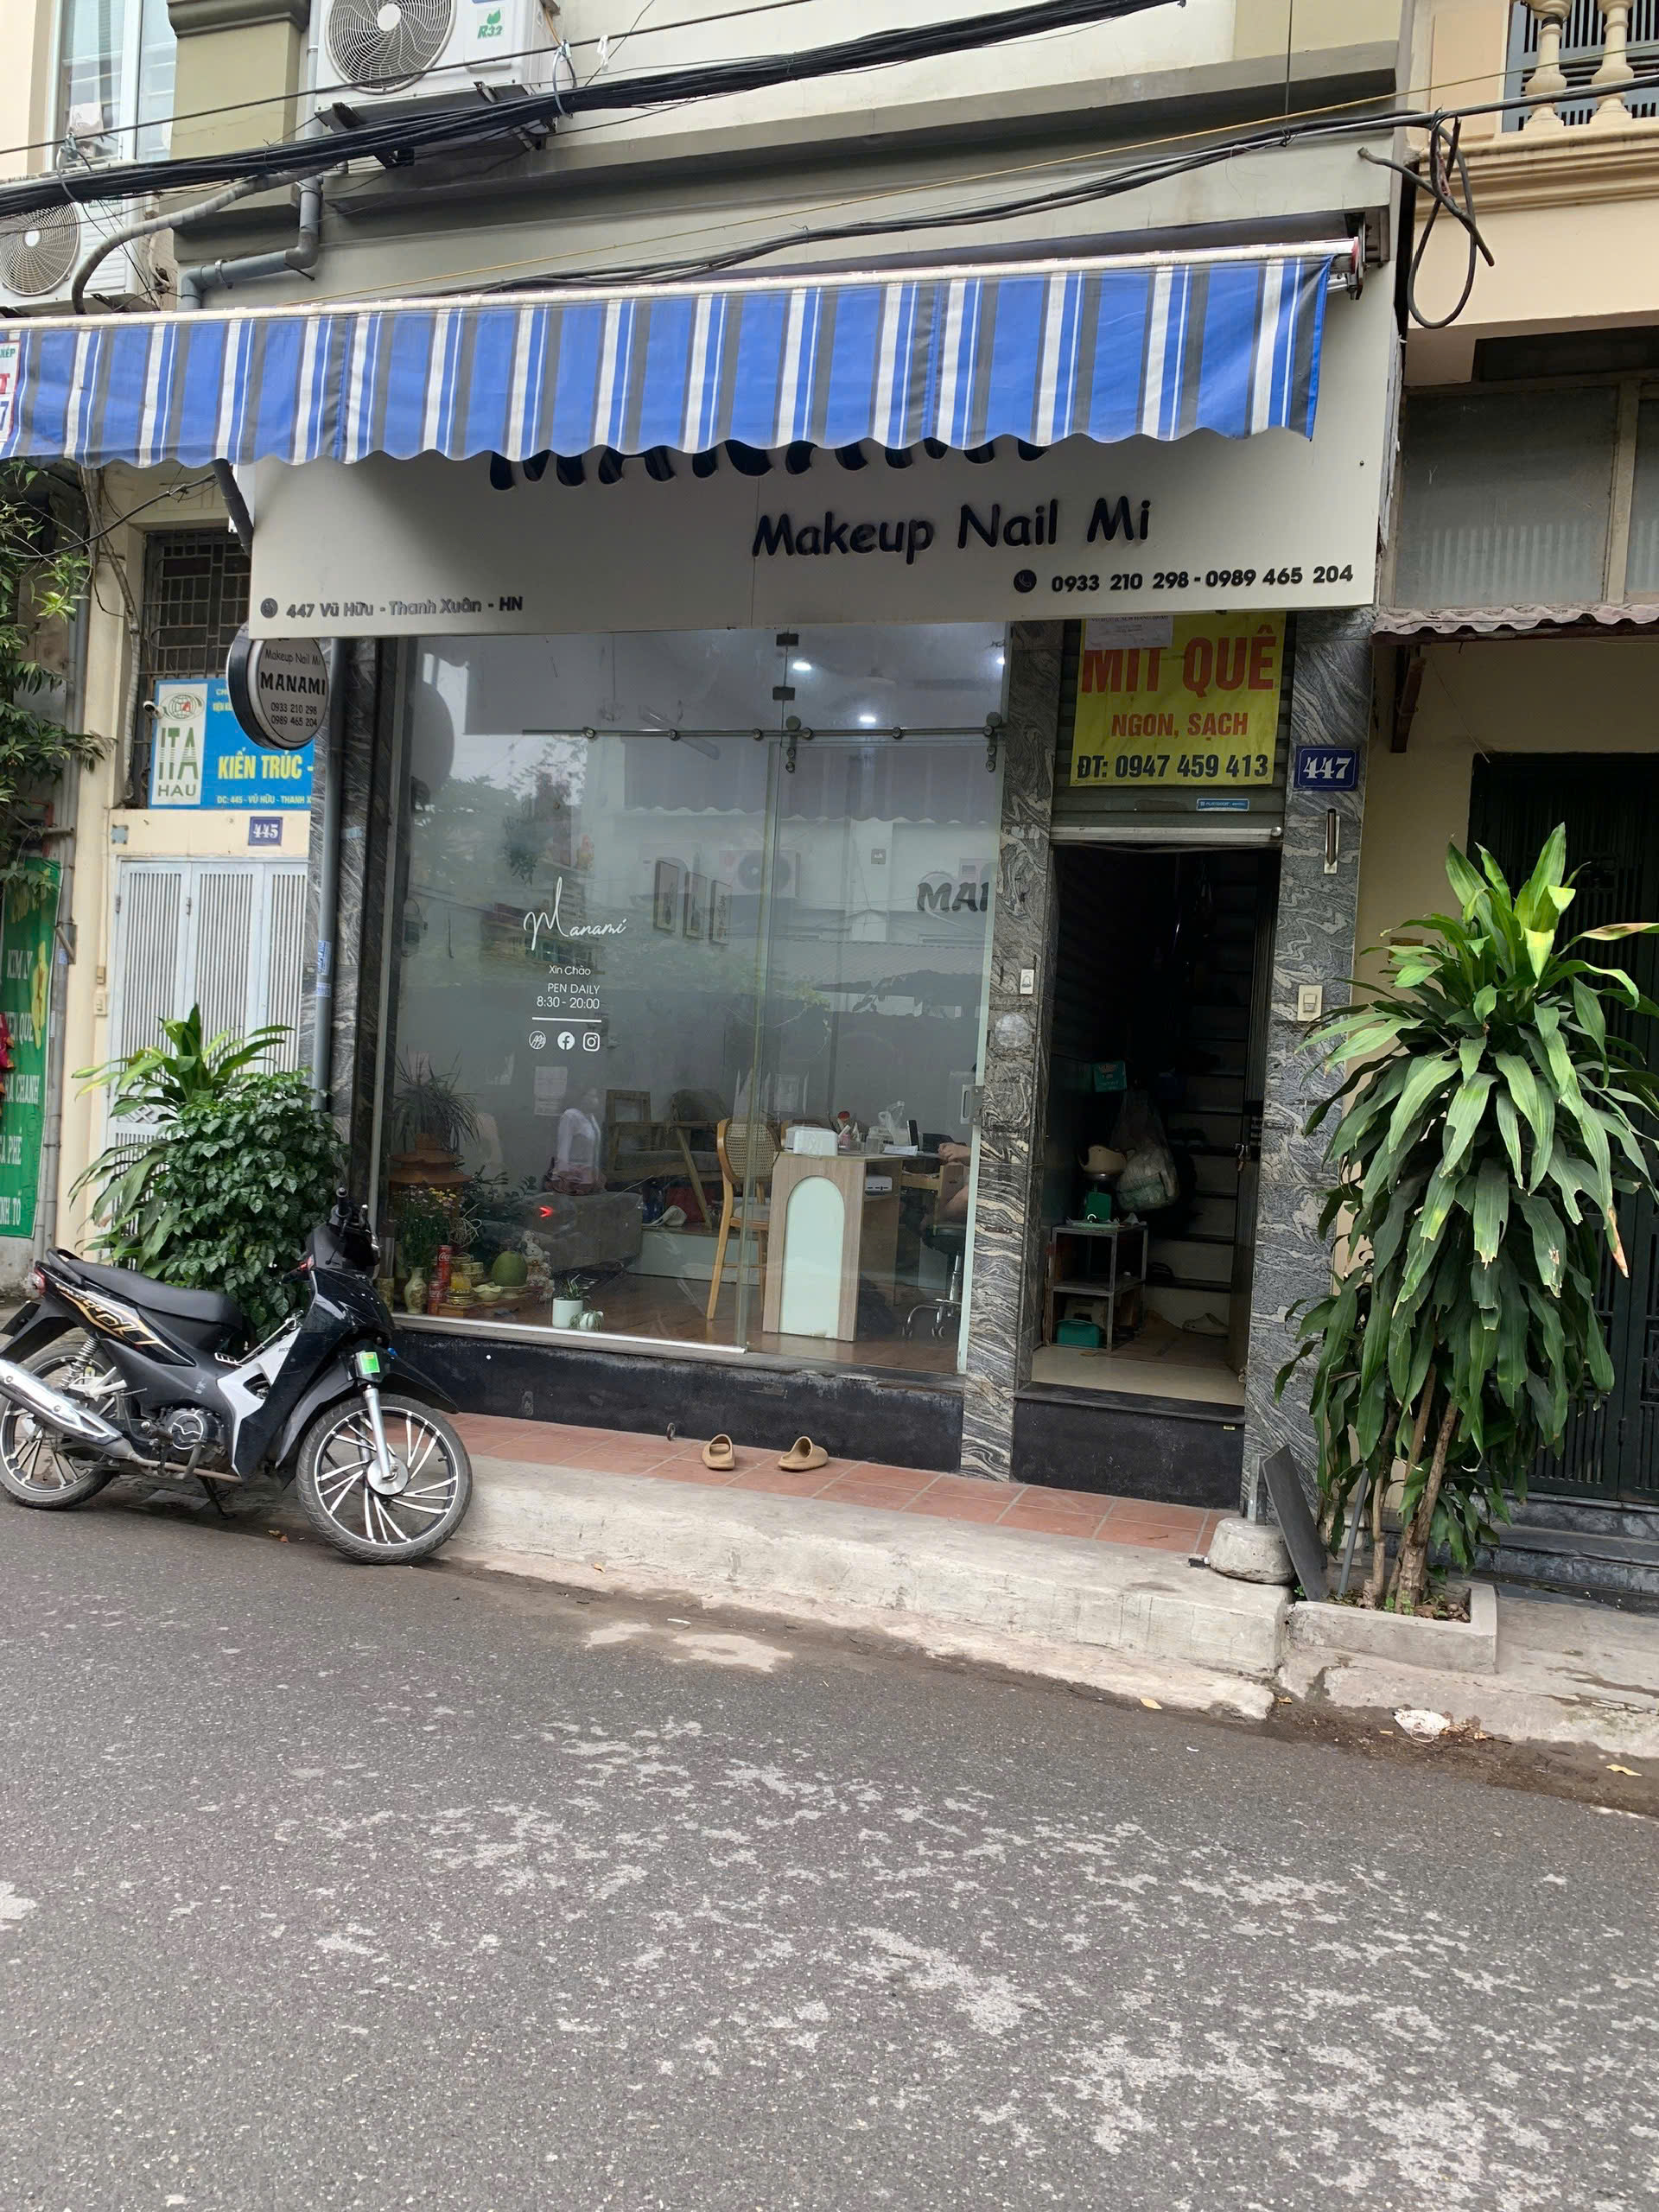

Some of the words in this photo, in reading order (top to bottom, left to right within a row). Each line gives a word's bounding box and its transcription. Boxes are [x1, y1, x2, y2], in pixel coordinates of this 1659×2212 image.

[477, 25, 503, 39] R32
[752, 511, 934, 565] Makeup
[957, 499, 1058, 549] Nail
[1086, 495, 1151, 543] Mi
[1051, 575, 1100, 592] 0933
[1109, 573, 1142, 591] 210
[1206, 569, 1256, 588] 0989
[1262, 567, 1303, 585] 465
[1313, 564, 1353, 583] 204
[286, 603, 315, 618] 447
[320, 602, 340, 617] Vũ
[389, 599, 436, 616] Thanh
[439, 598, 482, 615] Xuân
[499, 595, 524, 612] HN
[264, 649, 293, 665] Makeup
[296, 652, 309, 664] Nail
[1182, 624, 1277, 698] QUÊ
[260, 671, 326, 696] MANAMI
[270, 702, 288, 712] 0933
[290, 703, 303, 714] 210
[305, 705, 317, 715] 298
[270, 715, 288, 726] 0989
[290, 716, 303, 727] 465
[305, 717, 318, 727] 204
[1111, 713, 1179, 739] NGON,
[1187, 712, 1249, 741] SẠCH
[218, 747, 257, 779] KIẾN
[261, 750, 302, 779] TRÚC
[1116, 754, 1170, 778] 0947
[1177, 754, 1218, 778] 459
[1225, 754, 1268, 778] 413
[1303, 756, 1352, 779] 447
[157, 785, 197, 797] HAU
[253, 823, 279, 838] 445
[523, 876, 627, 951] Manami
[549, 964, 563, 975] Xin
[564, 964, 592, 976] Chào
[547, 982, 567, 993] PEN
[570, 983, 601, 995] DAILY
[536, 996, 561, 1008] 8:30
[569, 997, 601, 1009] 20:00
